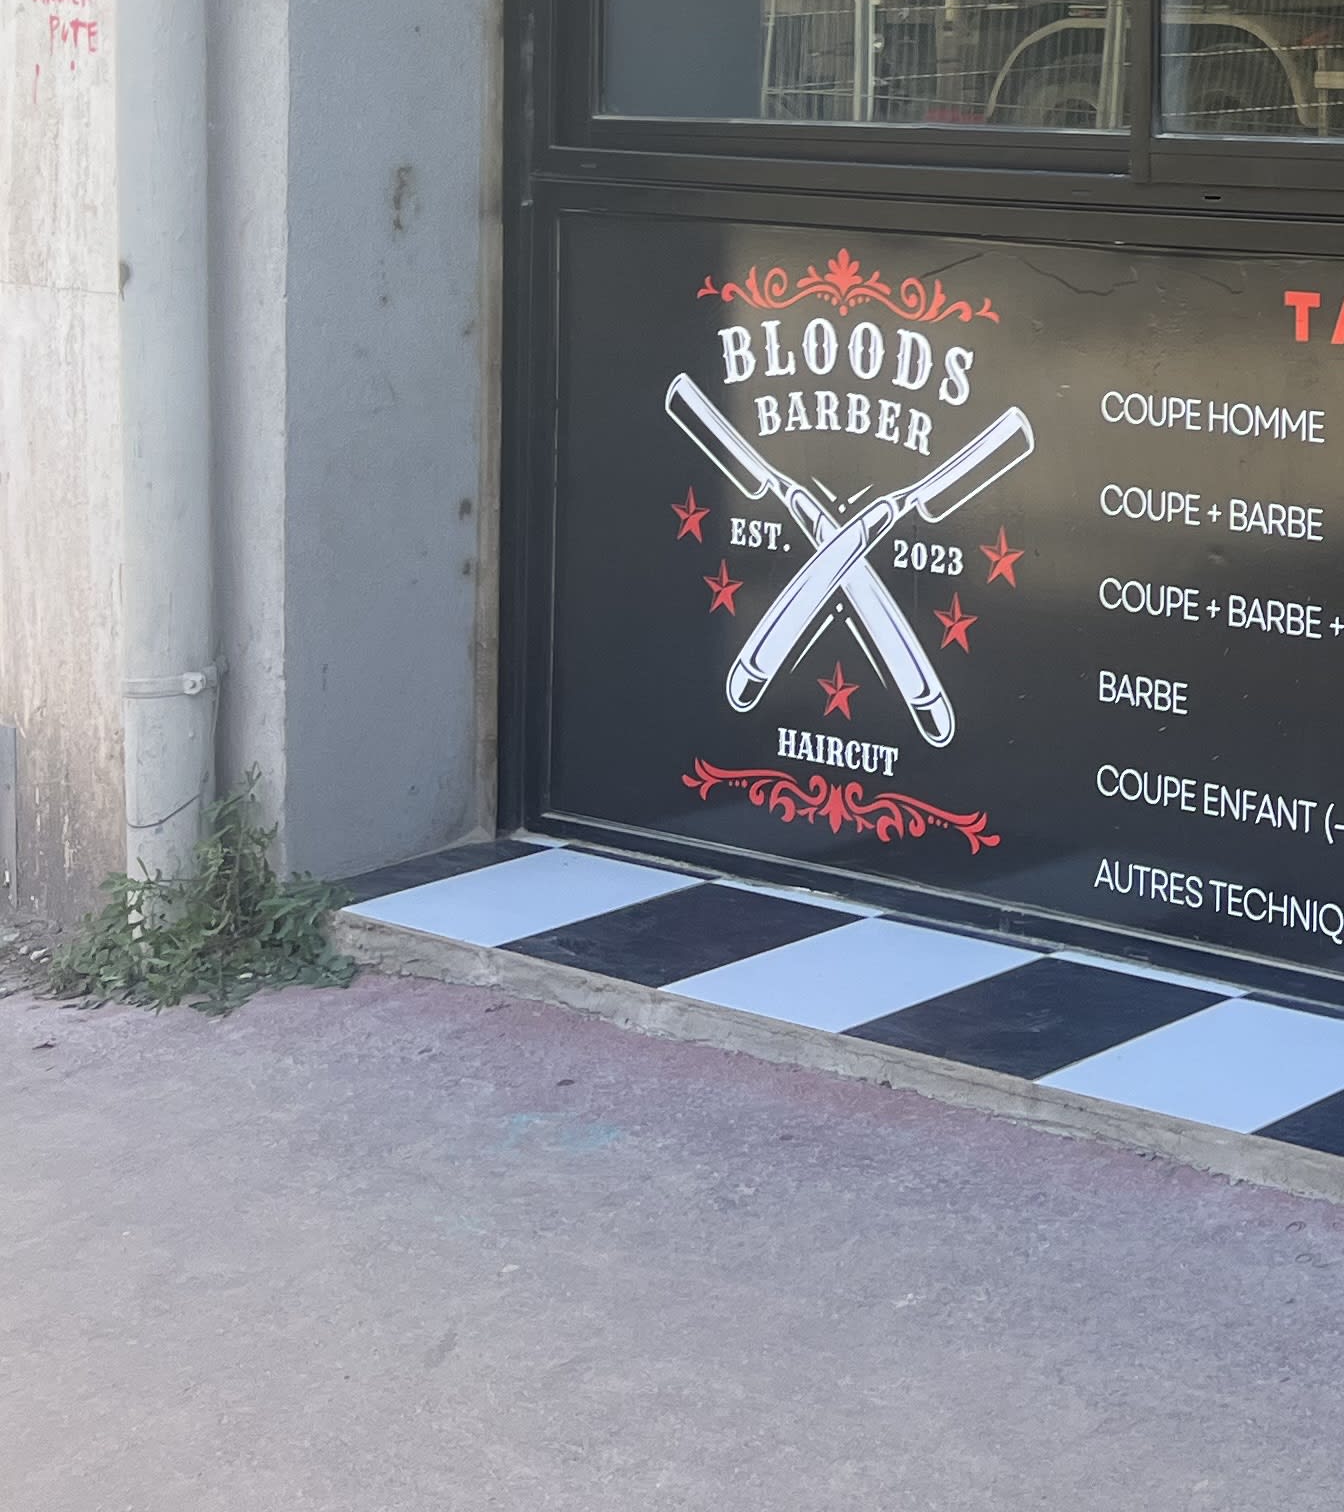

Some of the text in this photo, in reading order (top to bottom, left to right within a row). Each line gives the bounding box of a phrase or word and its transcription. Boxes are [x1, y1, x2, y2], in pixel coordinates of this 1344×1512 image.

[717, 317, 974, 406] BLOODS
[754, 390, 934, 456] BARBER
[1100, 391, 1326, 444] COUPE HOMME
[730, 517, 792, 553] EST.
[1100, 484, 1324, 541] COUPE + BARBE
[893, 539, 965, 577] 2023
[1098, 577, 1199, 623] COUPE
[1205, 600, 1221, 618] +
[1228, 592, 1322, 640] BARBE
[1329, 617, 1344, 636] +
[1099, 671, 1189, 716] BARBE
[777, 728, 899, 777] HAIRCUT
[1096, 764, 1197, 813] COUPE
[1203, 784, 1318, 835] ENFANT
[1094, 858, 1203, 909] AUTRES
